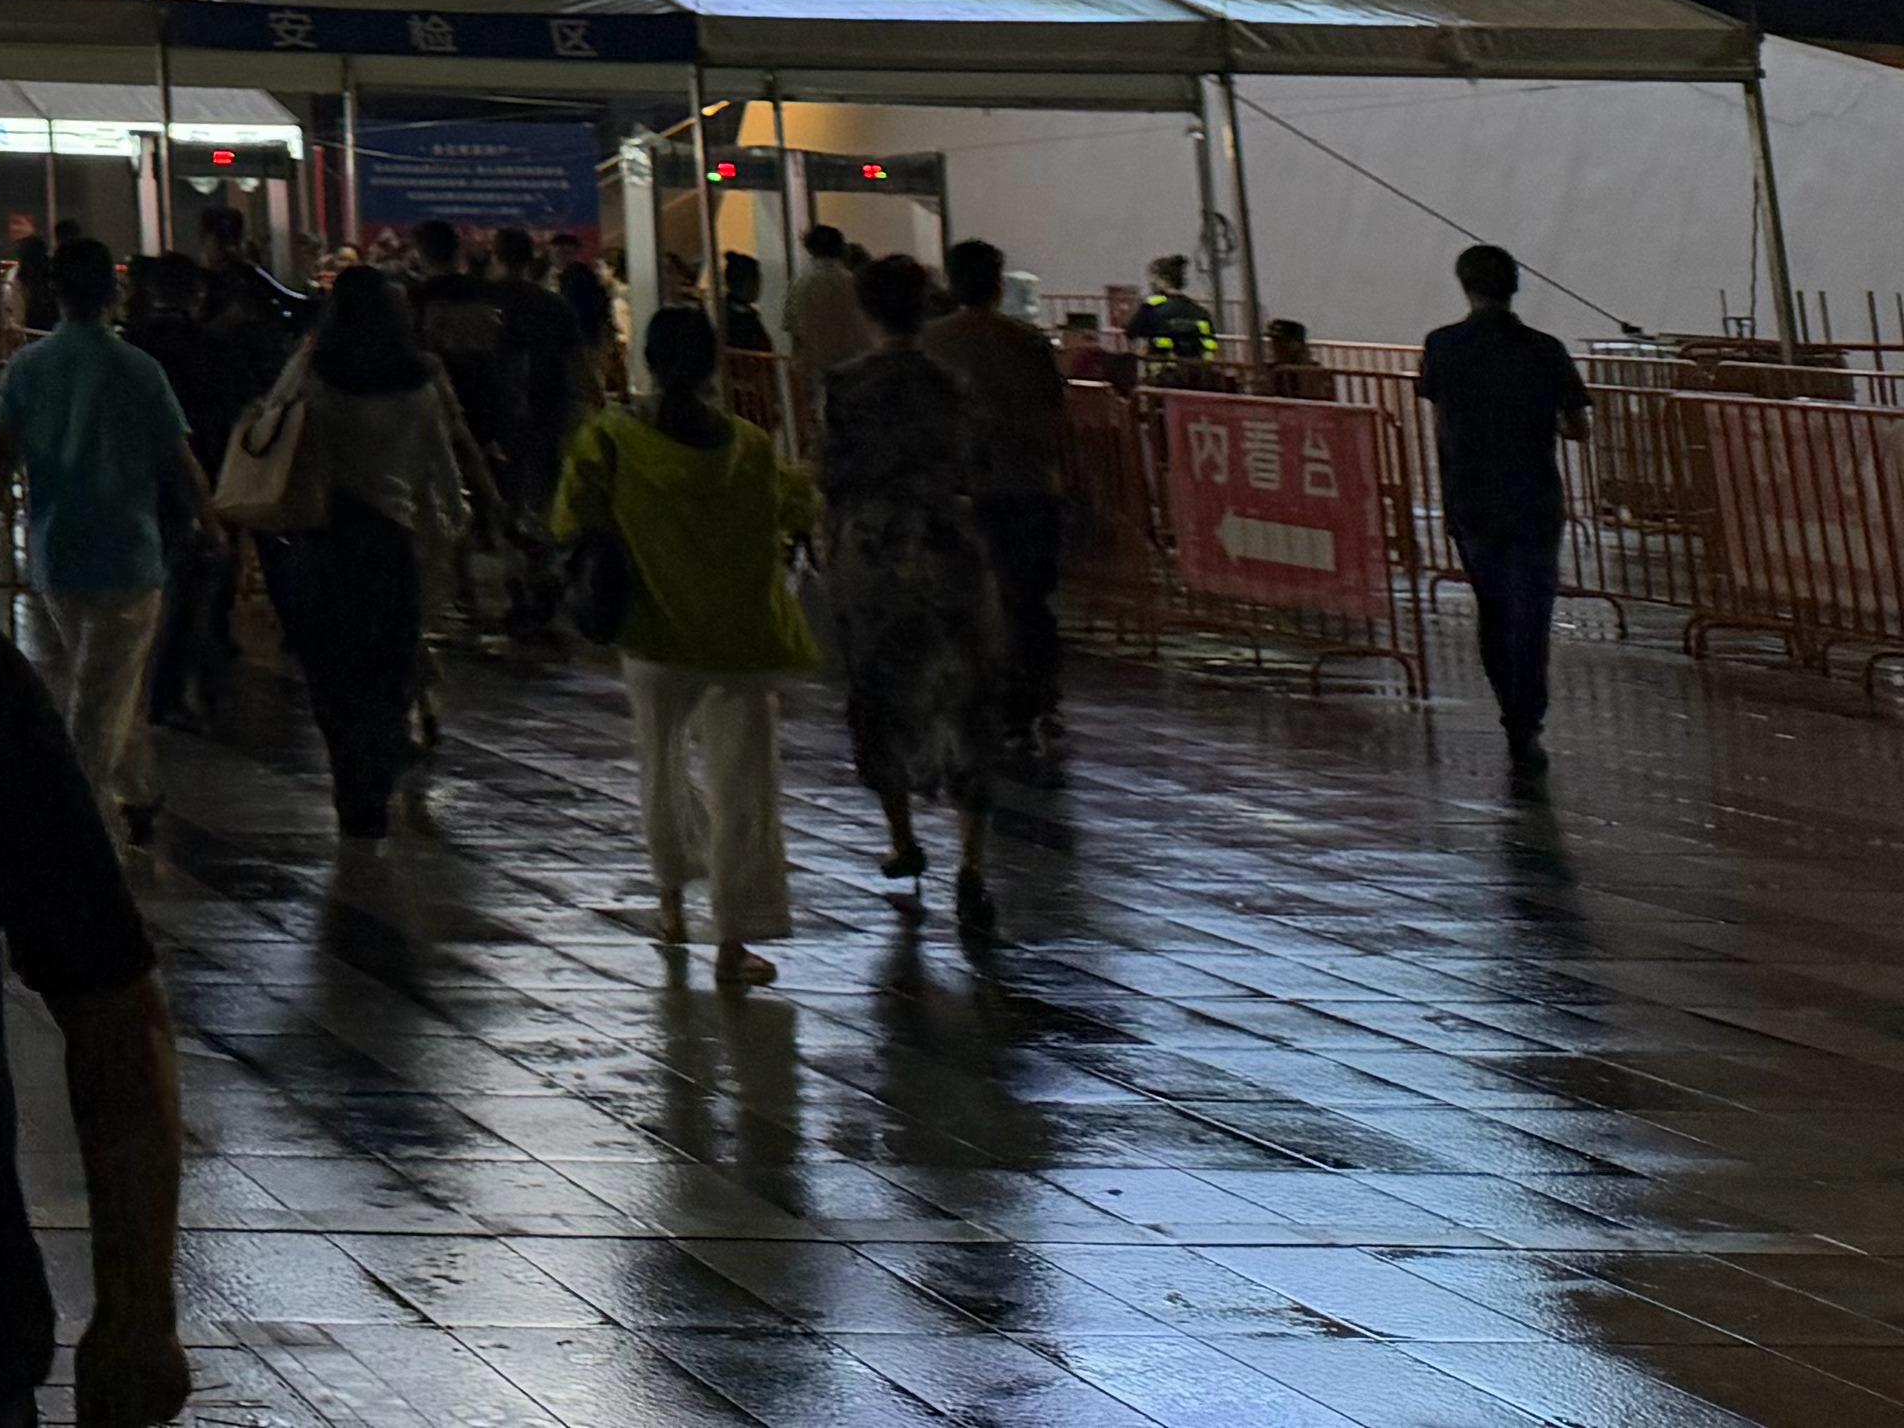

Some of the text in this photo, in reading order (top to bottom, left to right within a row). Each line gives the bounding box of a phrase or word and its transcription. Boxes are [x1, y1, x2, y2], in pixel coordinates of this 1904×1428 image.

[267, 10, 598, 59] 安检区
[1185, 415, 1339, 499] 内看台
